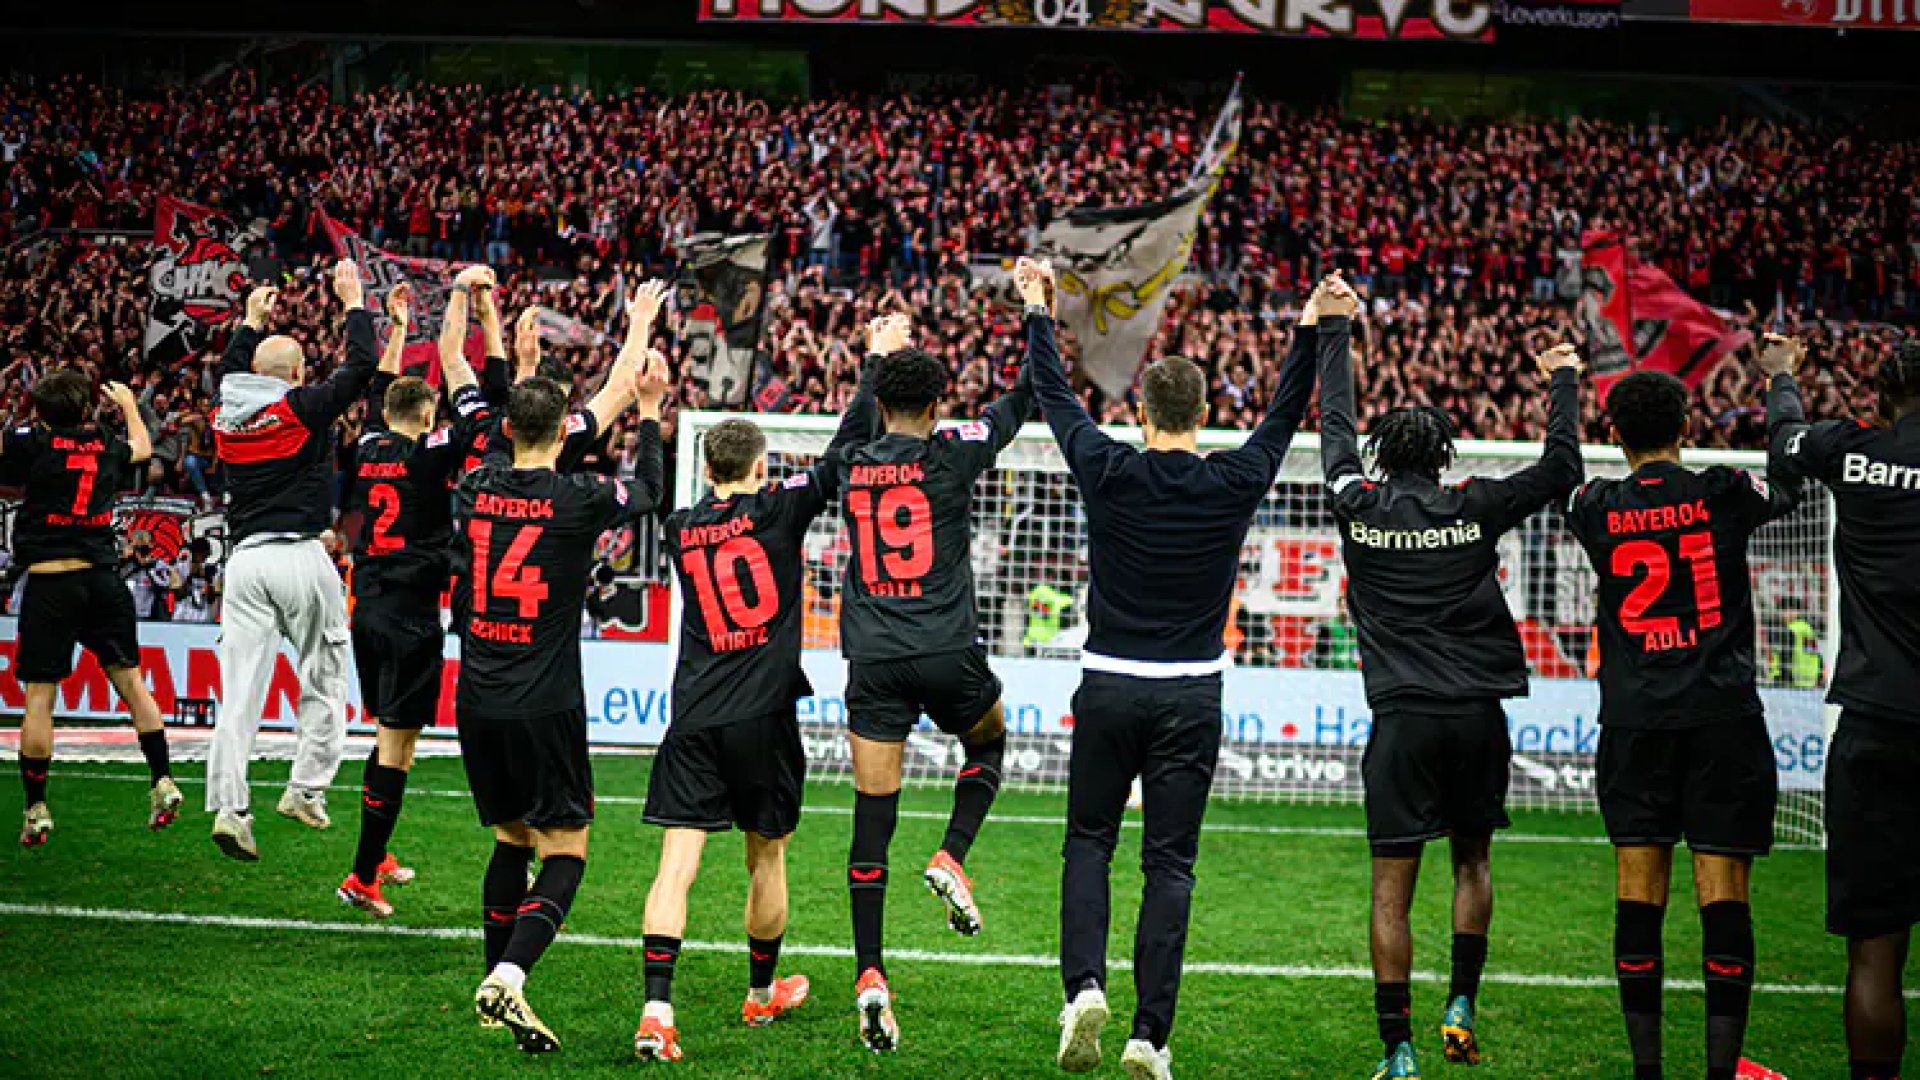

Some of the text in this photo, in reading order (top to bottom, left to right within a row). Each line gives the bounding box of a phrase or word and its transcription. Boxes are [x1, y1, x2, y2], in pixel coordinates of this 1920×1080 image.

[66, 454, 98, 515] 7
[367, 483, 404, 550] 2
[848, 486, 933, 581] 19
[1350, 519, 1480, 549] Barmenia
[467, 519, 549, 617] 14
[681, 536, 779, 636] 10
[1611, 532, 1721, 632] 21
[470, 618, 533, 643] SCHICK
[710, 627, 768, 652] WIRTZ
[1644, 628, 1698, 652] ADLI
[1257, 754, 1345, 782] trivo
